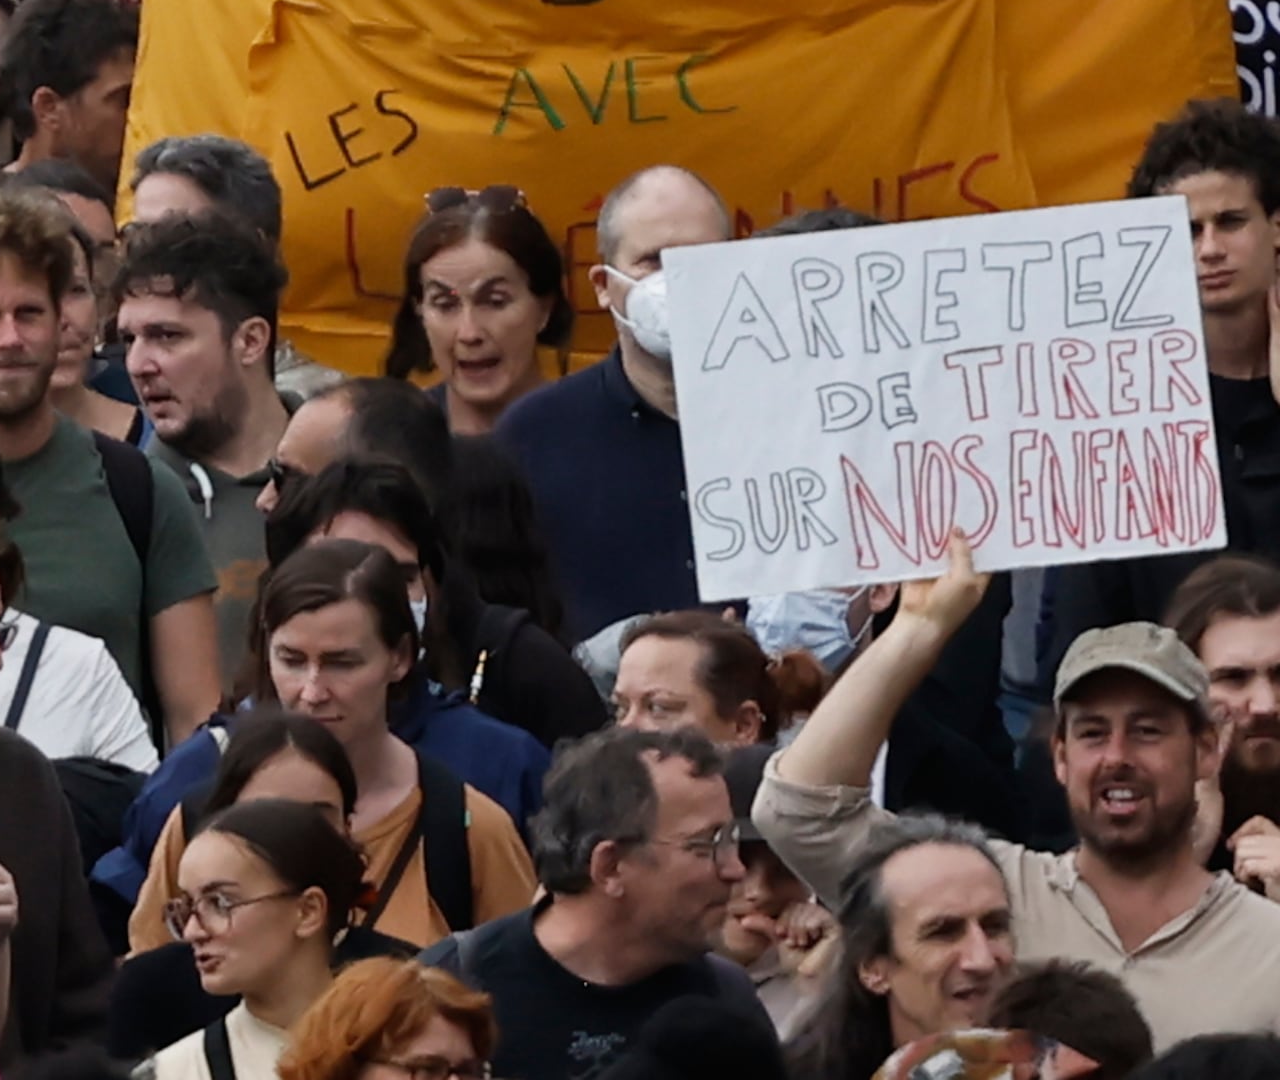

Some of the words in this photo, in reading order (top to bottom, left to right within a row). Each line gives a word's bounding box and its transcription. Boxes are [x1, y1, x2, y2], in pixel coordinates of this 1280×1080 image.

[284, 89, 420, 192] LES
[493, 52, 738, 136] AVEC
[702, 224, 1175, 372] ARRETEZ
[816, 371, 918, 434] DE
[944, 328, 1203, 421] TIRER
[694, 467, 839, 562] SUR
[839, 434, 1000, 571] NOS
[1009, 420, 1218, 550] ENFANTS
